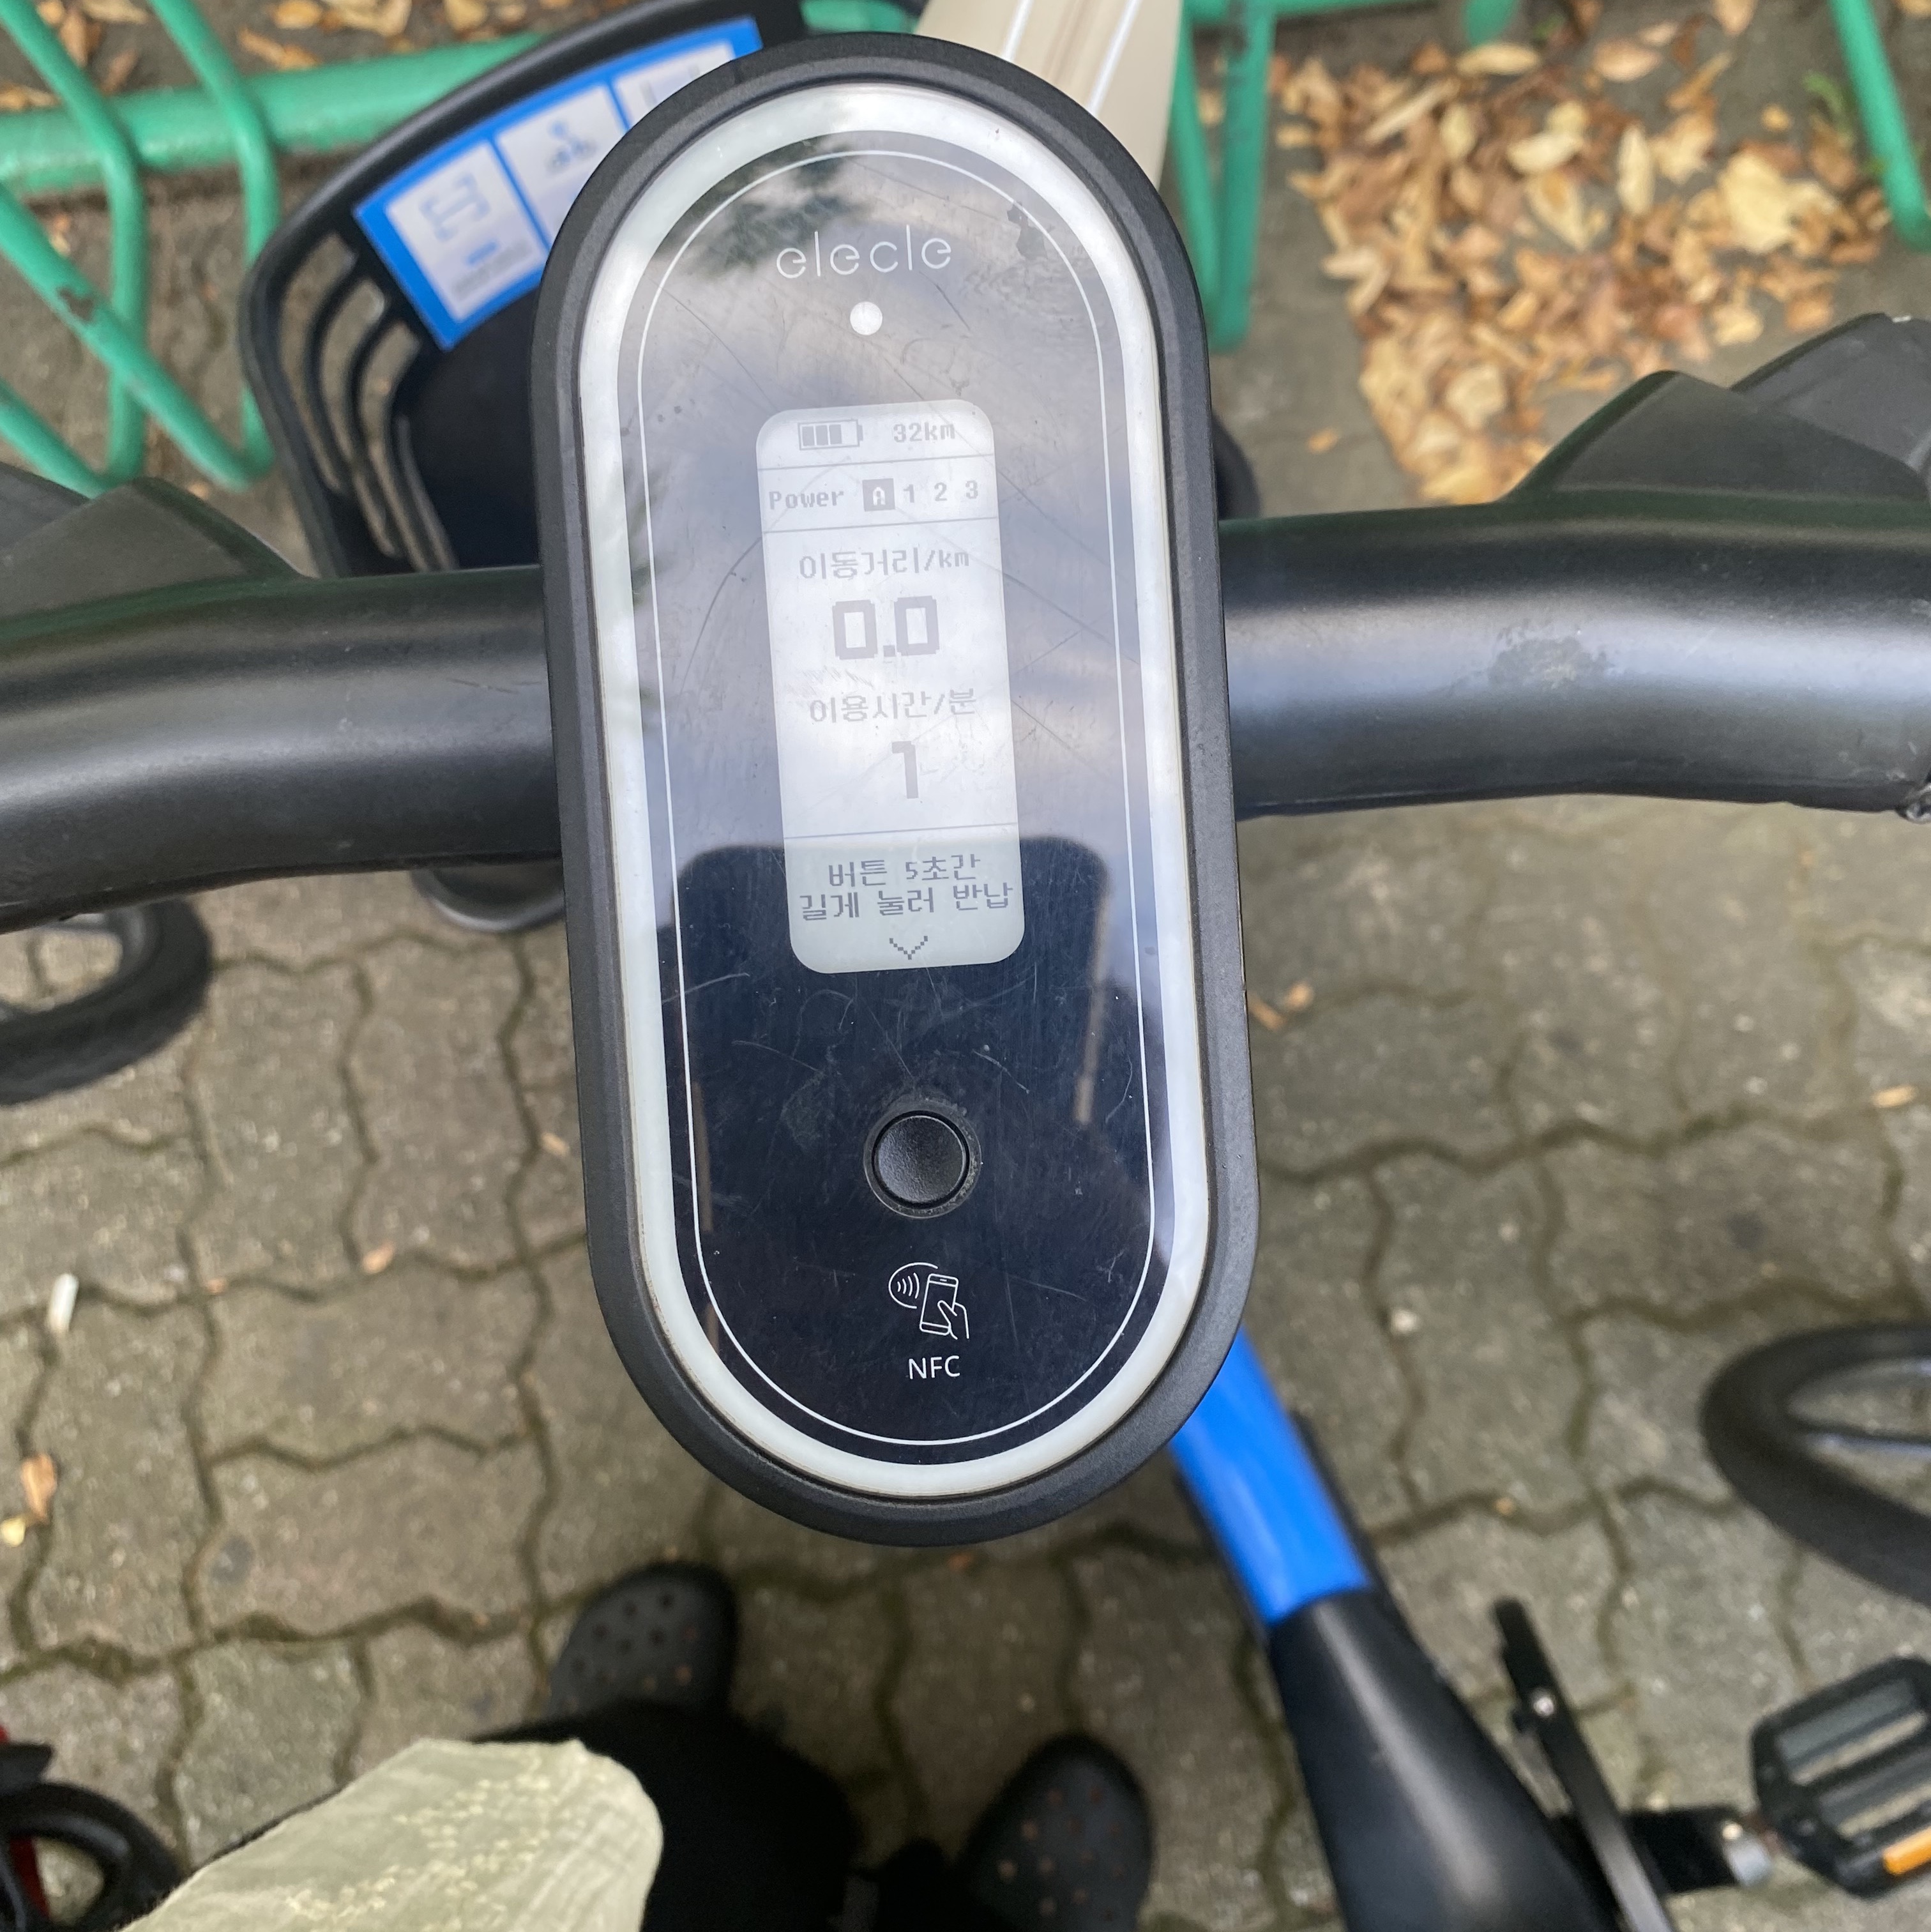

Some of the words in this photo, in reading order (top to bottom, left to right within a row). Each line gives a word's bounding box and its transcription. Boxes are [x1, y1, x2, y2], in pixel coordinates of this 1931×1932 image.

[776, 225, 951, 278] elecle
[893, 422, 956, 443] 32km
[768, 489, 845, 510] Power
[903, 484, 915, 503] 1
[934, 482, 948, 501] 2
[965, 480, 979, 499] 3
[799, 547, 970, 579] 이동거리/km
[832, 595, 940, 660] 0.0
[809, 688, 976, 723] 이용시간/분
[891, 740, 919, 799] 1
[828, 859, 888, 887] 버튼
[905, 853, 981, 881] 5초간
[799, 892, 859, 921] 길게
[877, 886, 934, 916] 눌러
[953, 882, 1013, 911] 반납
[908, 1355, 960, 1380] NFC
